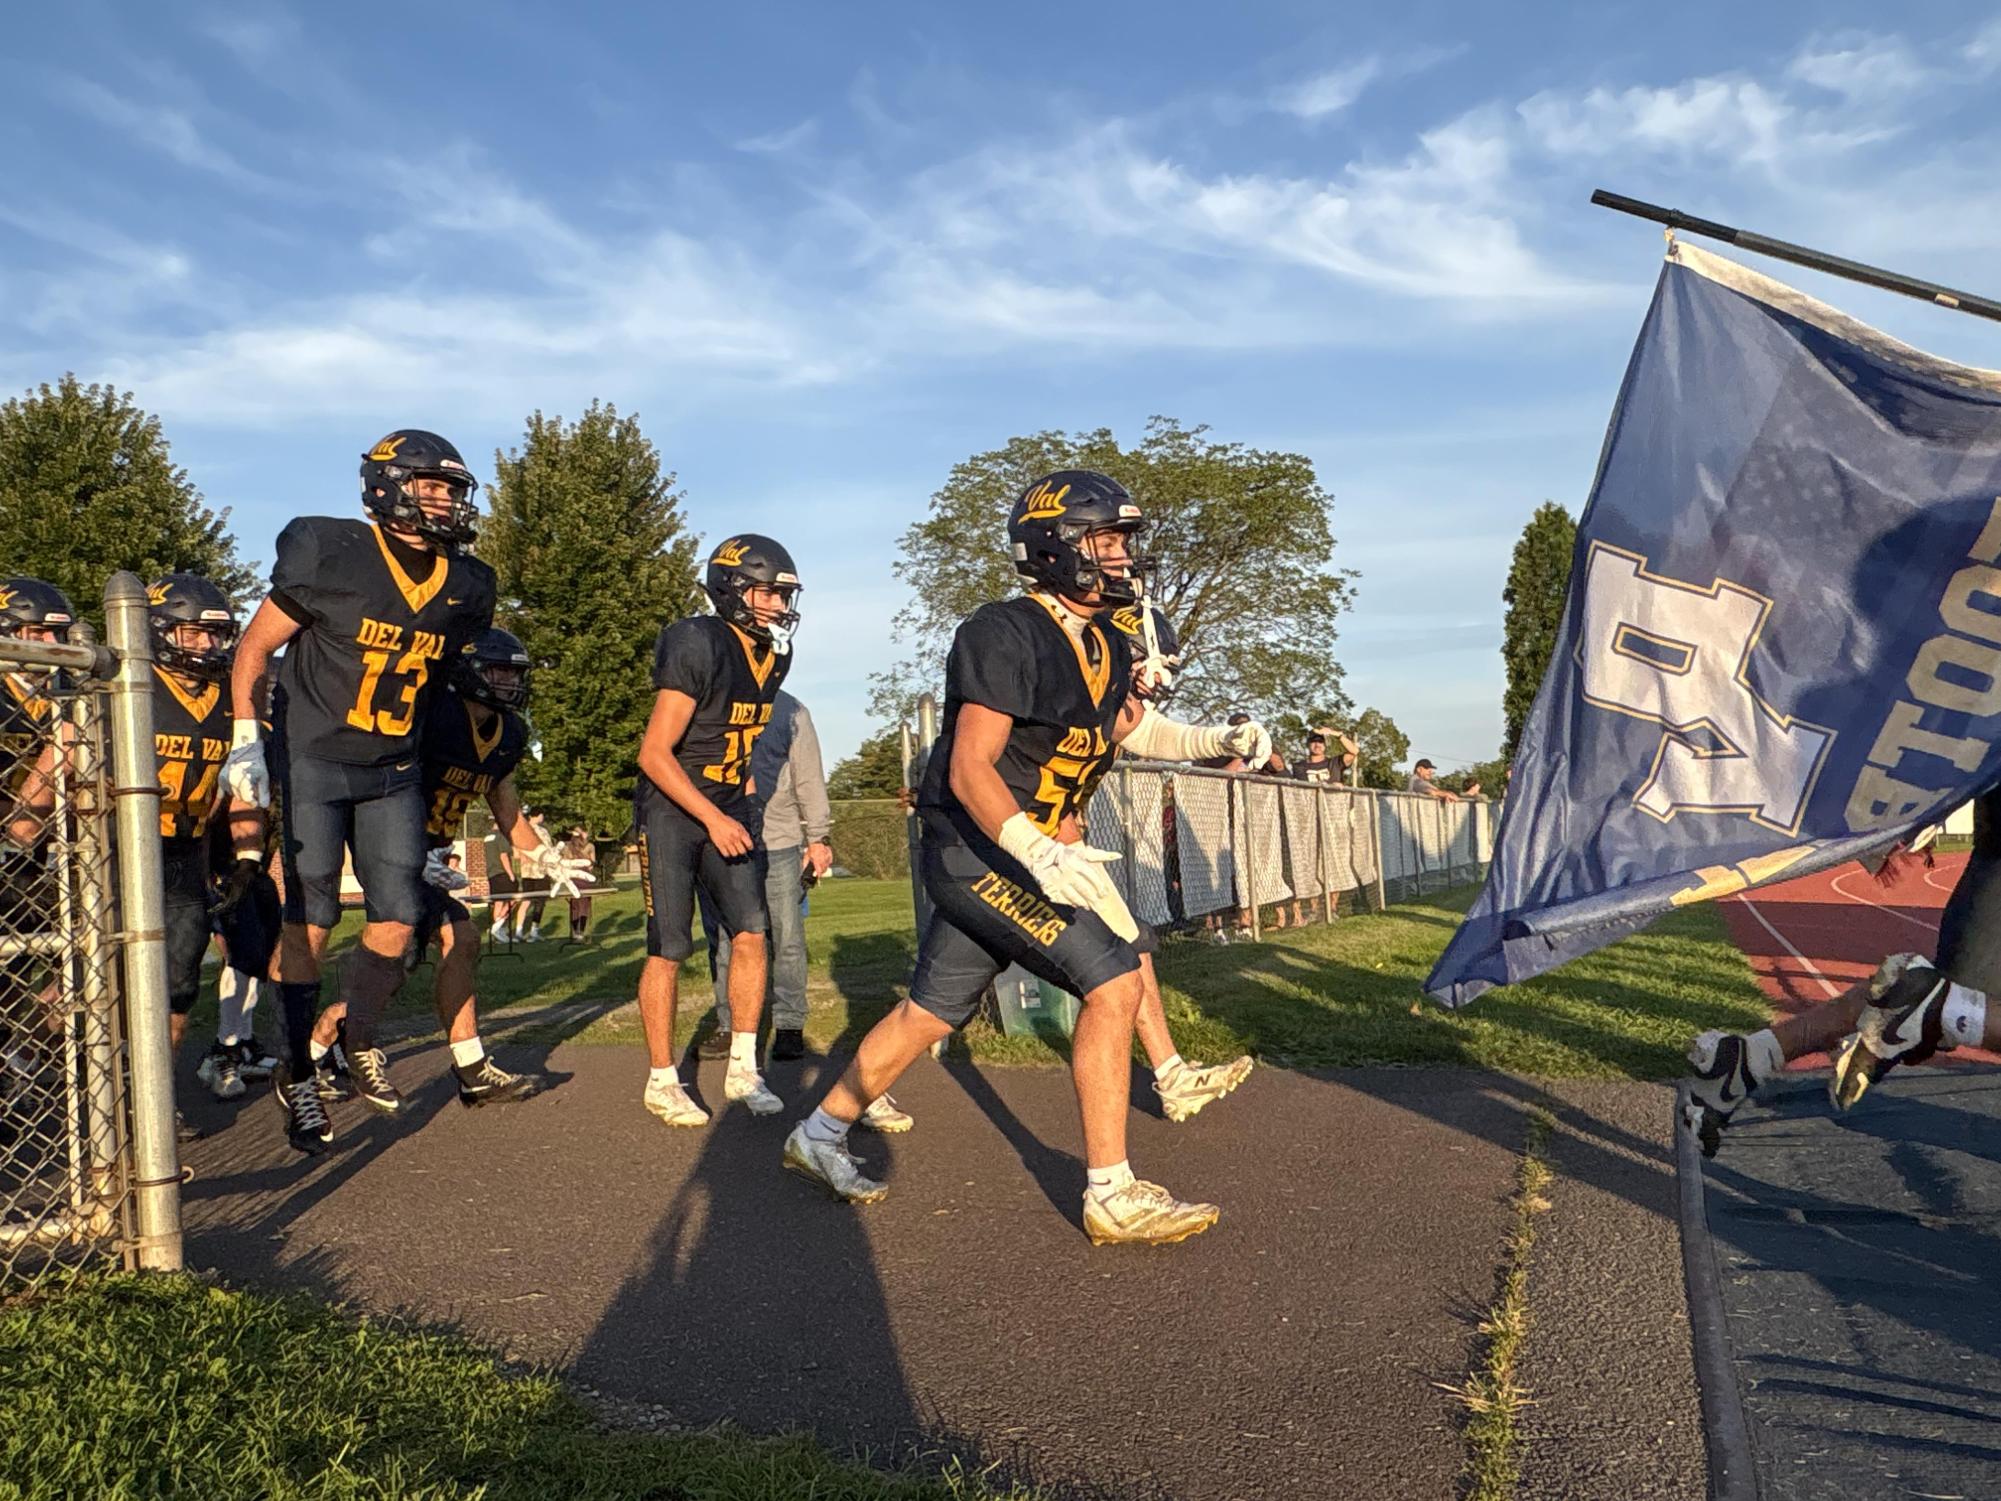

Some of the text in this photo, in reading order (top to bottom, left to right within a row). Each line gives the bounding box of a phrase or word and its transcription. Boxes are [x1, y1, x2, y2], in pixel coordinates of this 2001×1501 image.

[1018, 480, 1071, 525] Val
[356, 617, 403, 652] DEL
[346, 651, 428, 736] 13
[155, 734, 194, 760] DEL
